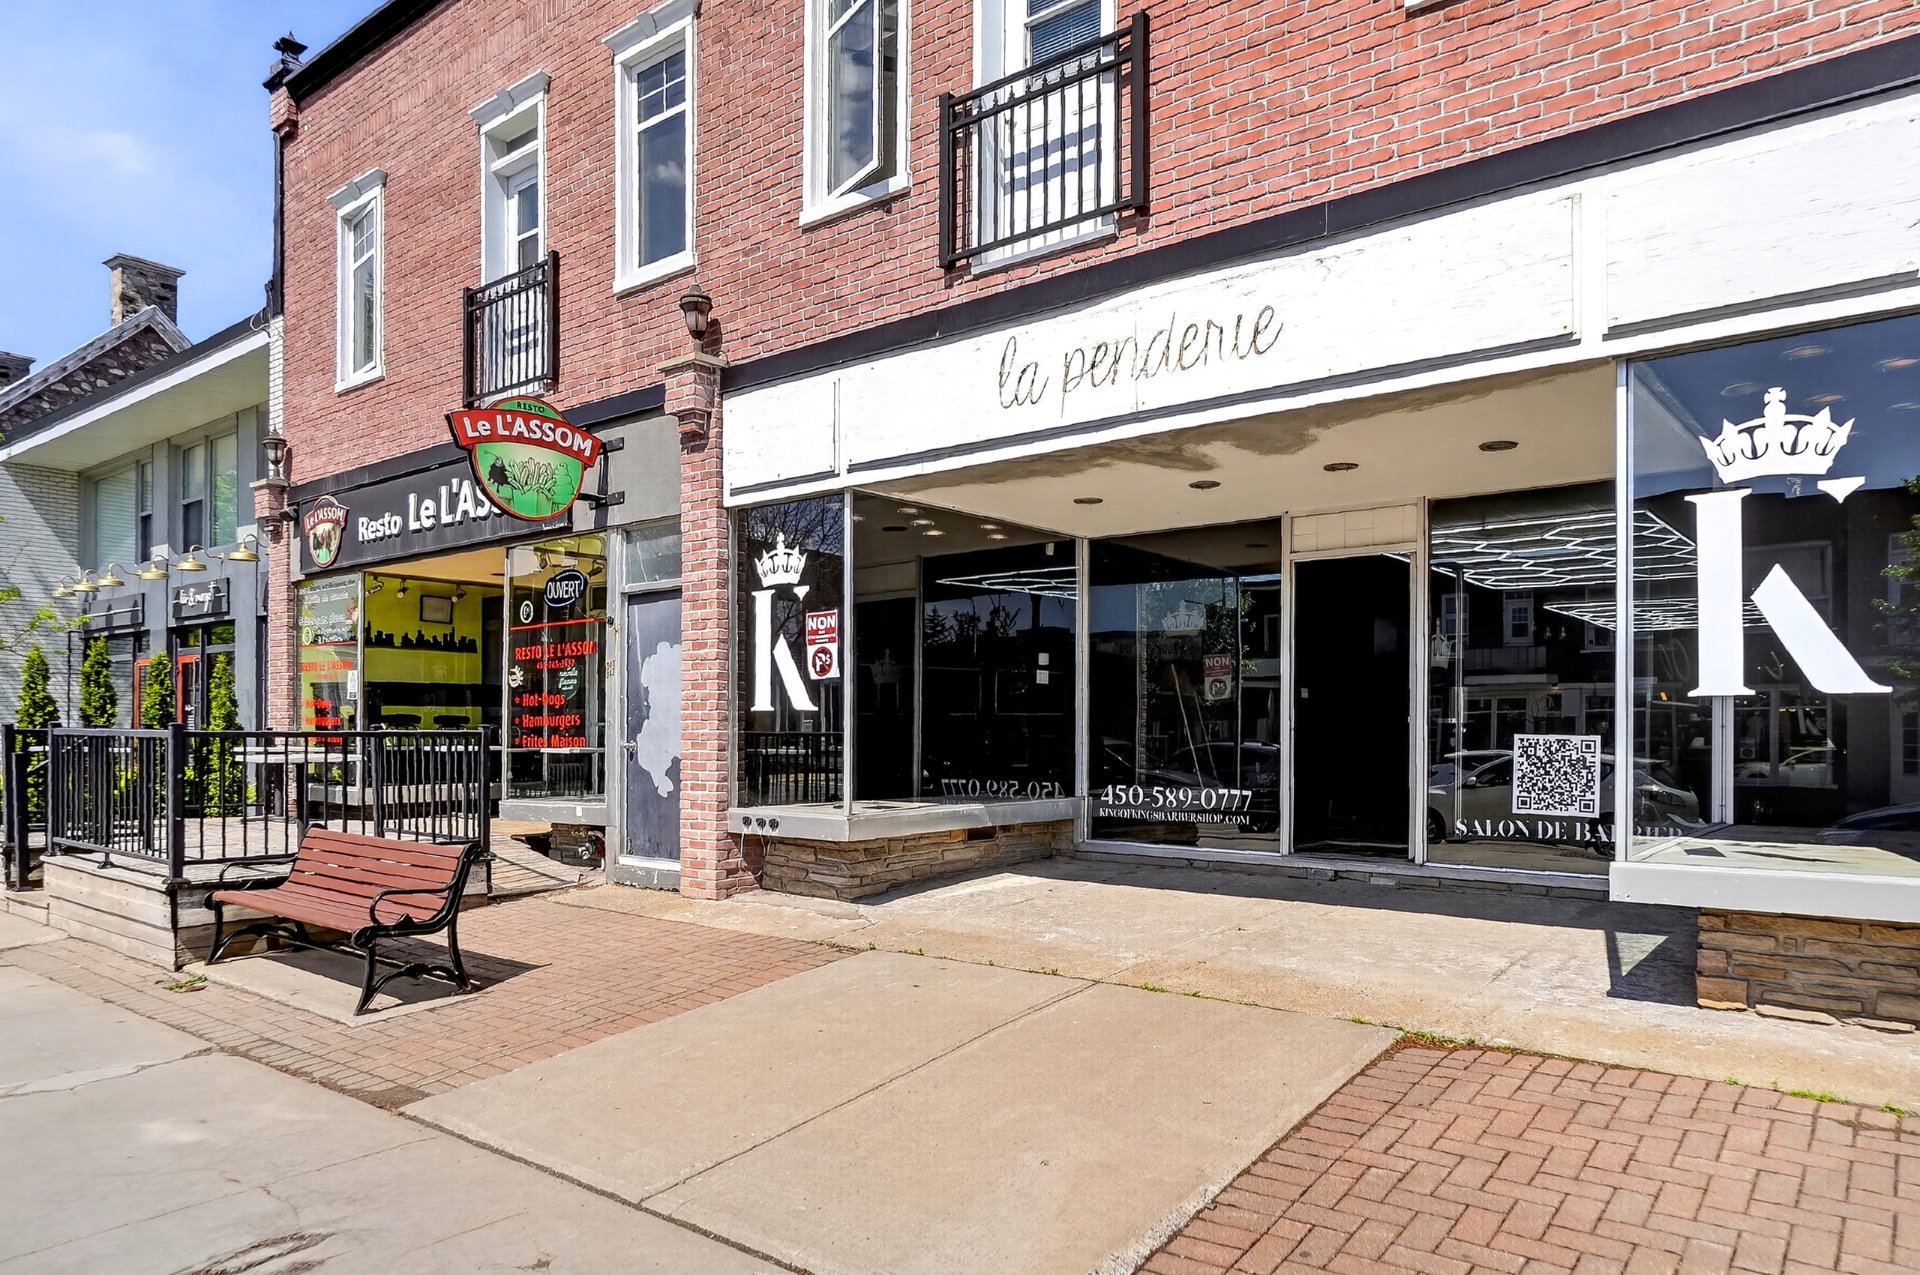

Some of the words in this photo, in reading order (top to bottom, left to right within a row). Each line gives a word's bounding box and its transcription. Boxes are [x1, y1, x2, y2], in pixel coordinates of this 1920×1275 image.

[998, 335, 1049, 409] la
[1060, 305, 1284, 419] penderie
[516, 401, 545, 414] RESTO
[462, 416, 491, 438] Le
[496, 414, 593, 457] L'ASSOM
[305, 515, 314, 527] Le
[314, 508, 345, 524] L'ASSOM
[358, 511, 403, 542] Resto
[408, 492, 437, 531] Le
[440, 477, 502, 524] L'AS
[546, 580, 581, 599] OUVERT
[808, 614, 836, 631] NON
[515, 645, 542, 660] RESTO
[545, 642, 554, 657] LE
[1205, 656, 1230, 668] NON
[522, 692, 565, 708] Hot-Dogs
[522, 714, 580, 730] Hamburgers
[551, 733, 587, 748] Maison
[1100, 784, 1252, 812] 450-589-0777
[1099, 807, 1250, 825] KINGOFKINGSBARBERSHOP.COM
[1455, 817, 1530, 838] SALON
[1537, 820, 1567, 840] DE
